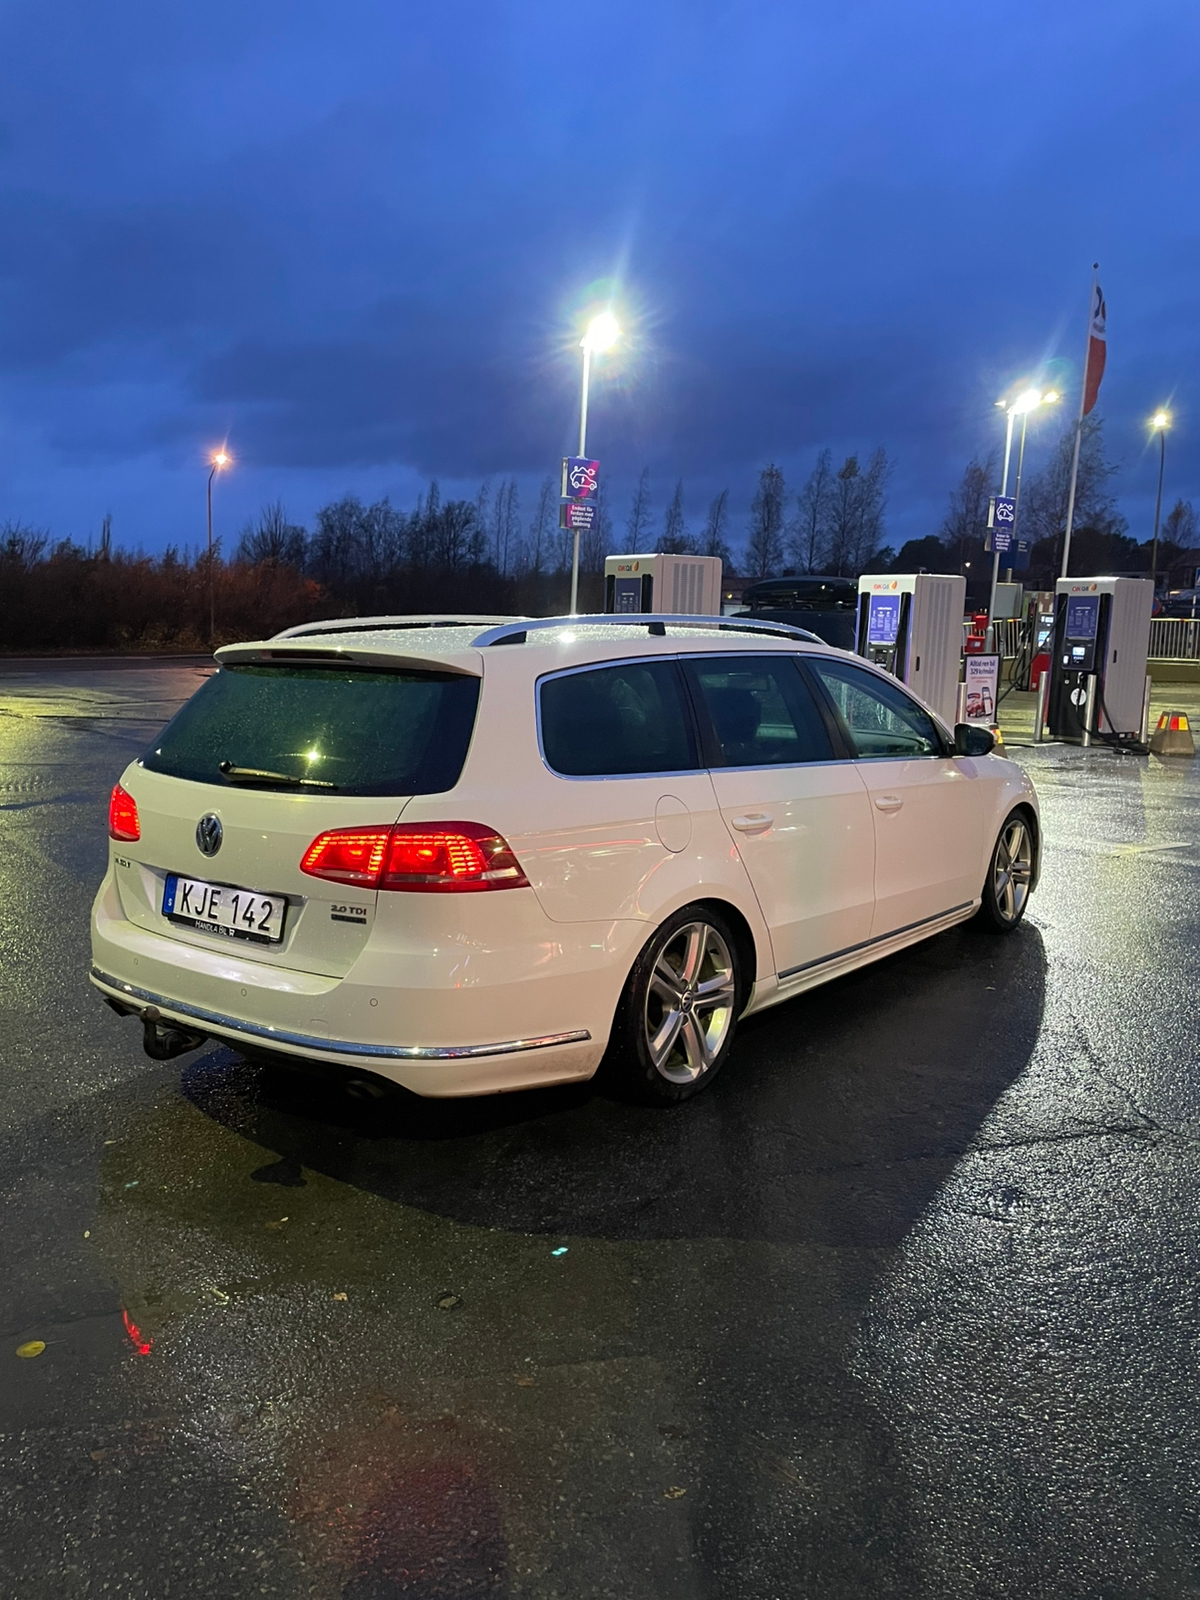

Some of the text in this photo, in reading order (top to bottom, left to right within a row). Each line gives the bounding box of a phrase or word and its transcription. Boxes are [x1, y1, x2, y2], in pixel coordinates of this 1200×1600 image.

[167, 898, 173, 907] S
[180, 882, 273, 932] KJE 142
[331, 904, 367, 916] 2.0 TDI
[194, 920, 227, 936] HANDLA BIL
